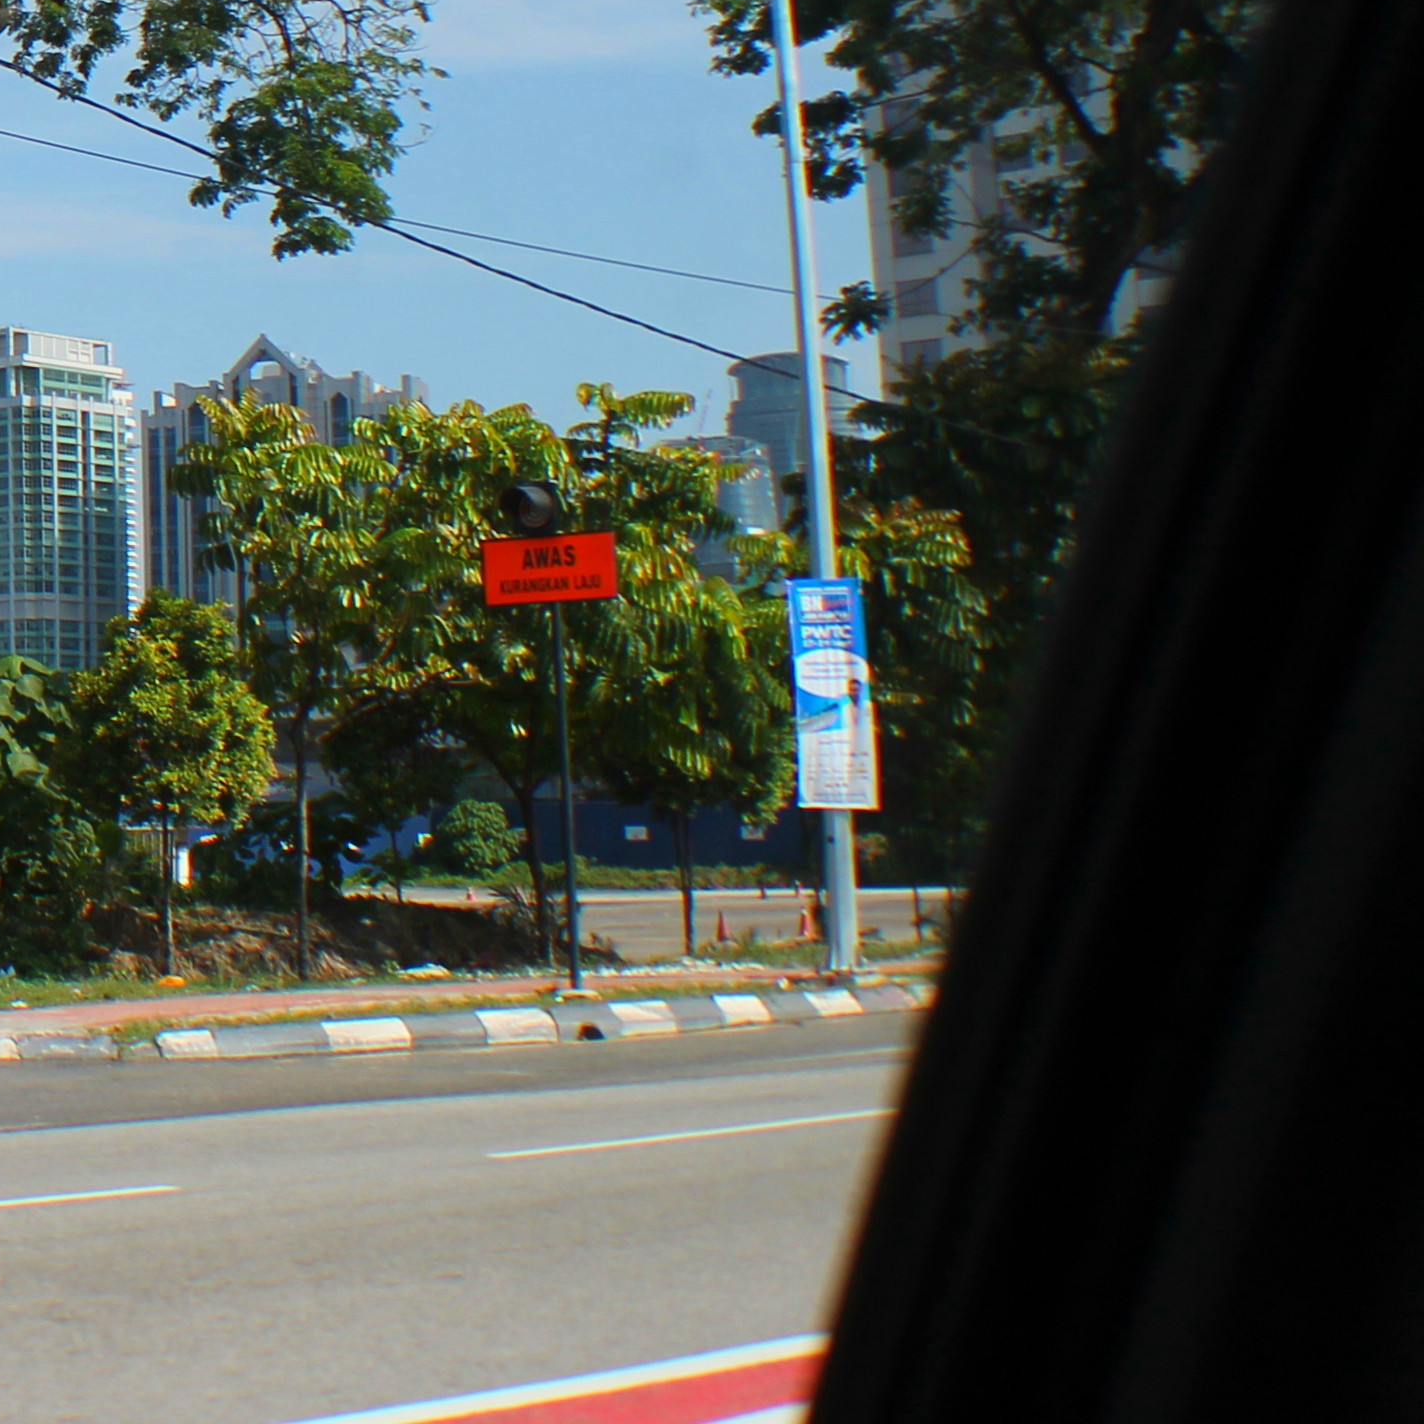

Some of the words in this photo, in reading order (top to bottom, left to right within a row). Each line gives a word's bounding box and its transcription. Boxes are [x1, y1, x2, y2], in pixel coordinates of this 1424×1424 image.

[523, 545, 576, 570] AWAS
[500, 577, 569, 594] KURANGKAN
[574, 574, 601, 590] LAJU
